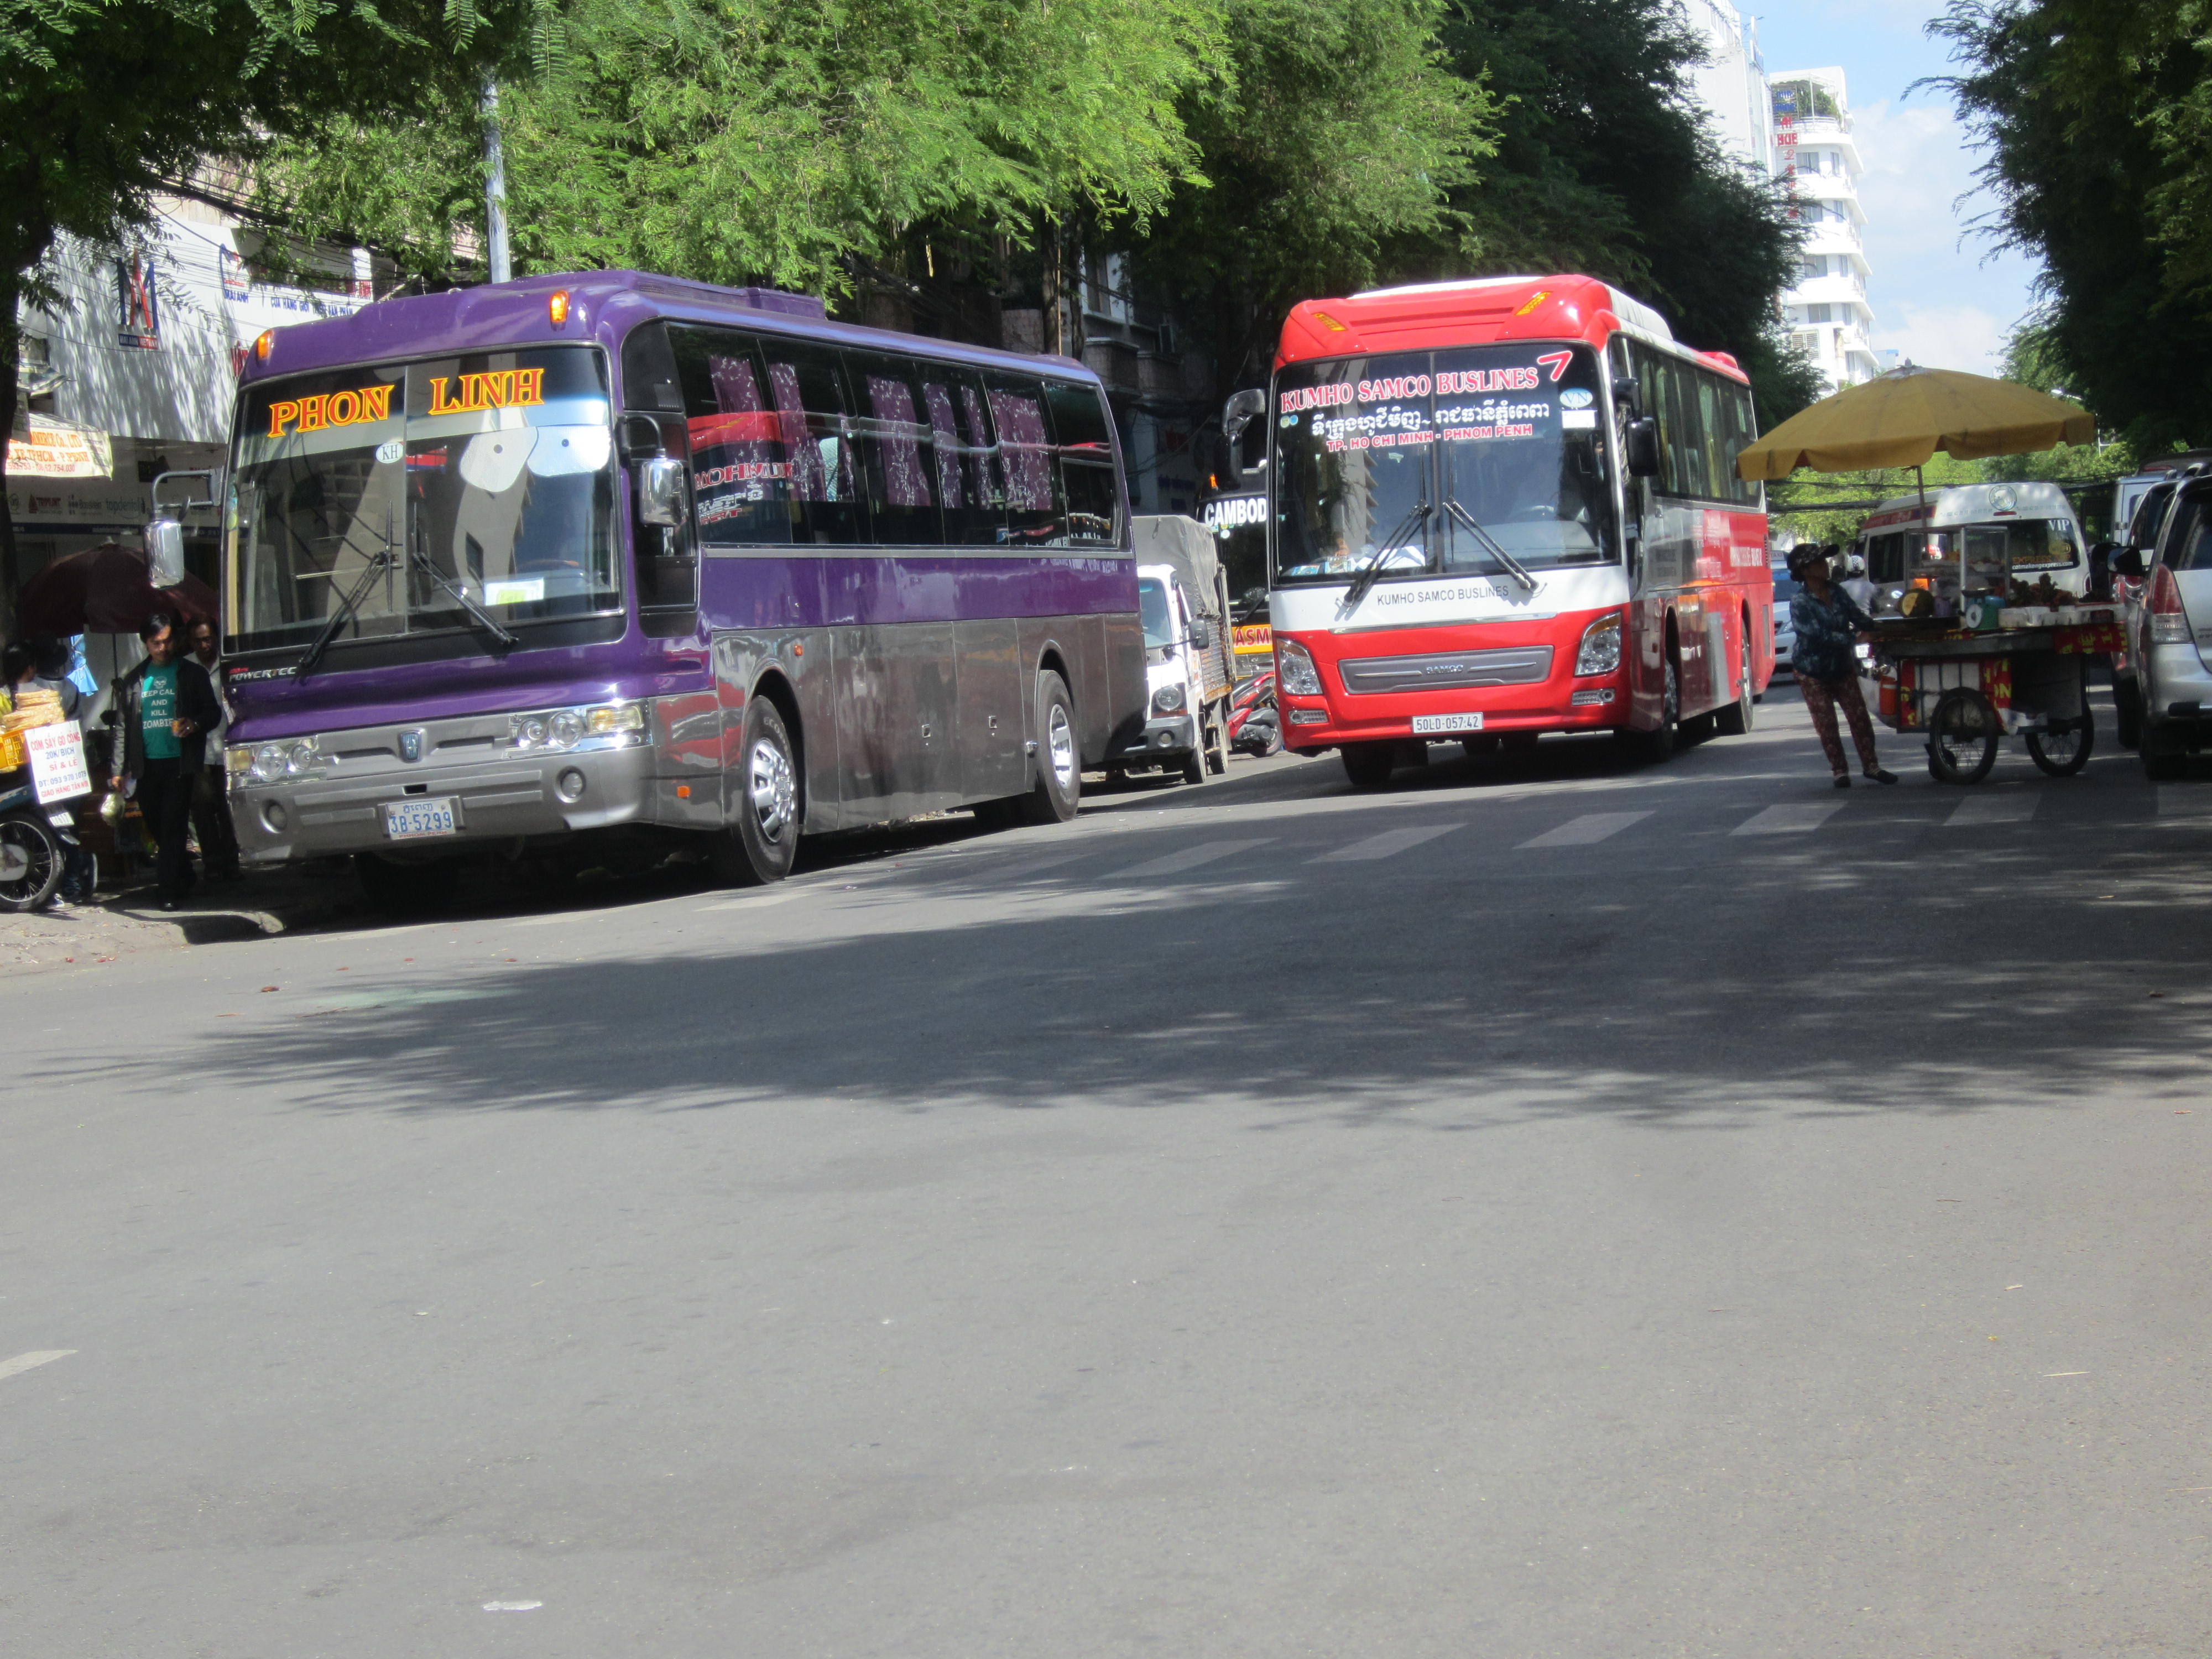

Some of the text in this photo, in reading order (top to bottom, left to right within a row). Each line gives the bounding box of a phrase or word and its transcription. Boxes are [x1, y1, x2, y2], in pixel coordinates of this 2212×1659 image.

[1281, 367, 1539, 413] KUMHO SAMCO BUSLINES
[1564, 392, 1590, 404] VN
[268, 368, 545, 439] PHON LINH
[1326, 441, 1348, 452] TP.
[1350, 437, 1370, 450] HO
[1371, 434, 1396, 447] CHI
[1397, 431, 1434, 445] MINH
[1443, 426, 1492, 441] PHNOM
[1495, 424, 1533, 437] PENH
[382, 445, 398, 460] KH
[2048, 519, 2070, 531] VIP
[1377, 585, 1509, 606] KUMHO SAMCO BUSLINES
[389, 811, 452, 833] 3B-5299
